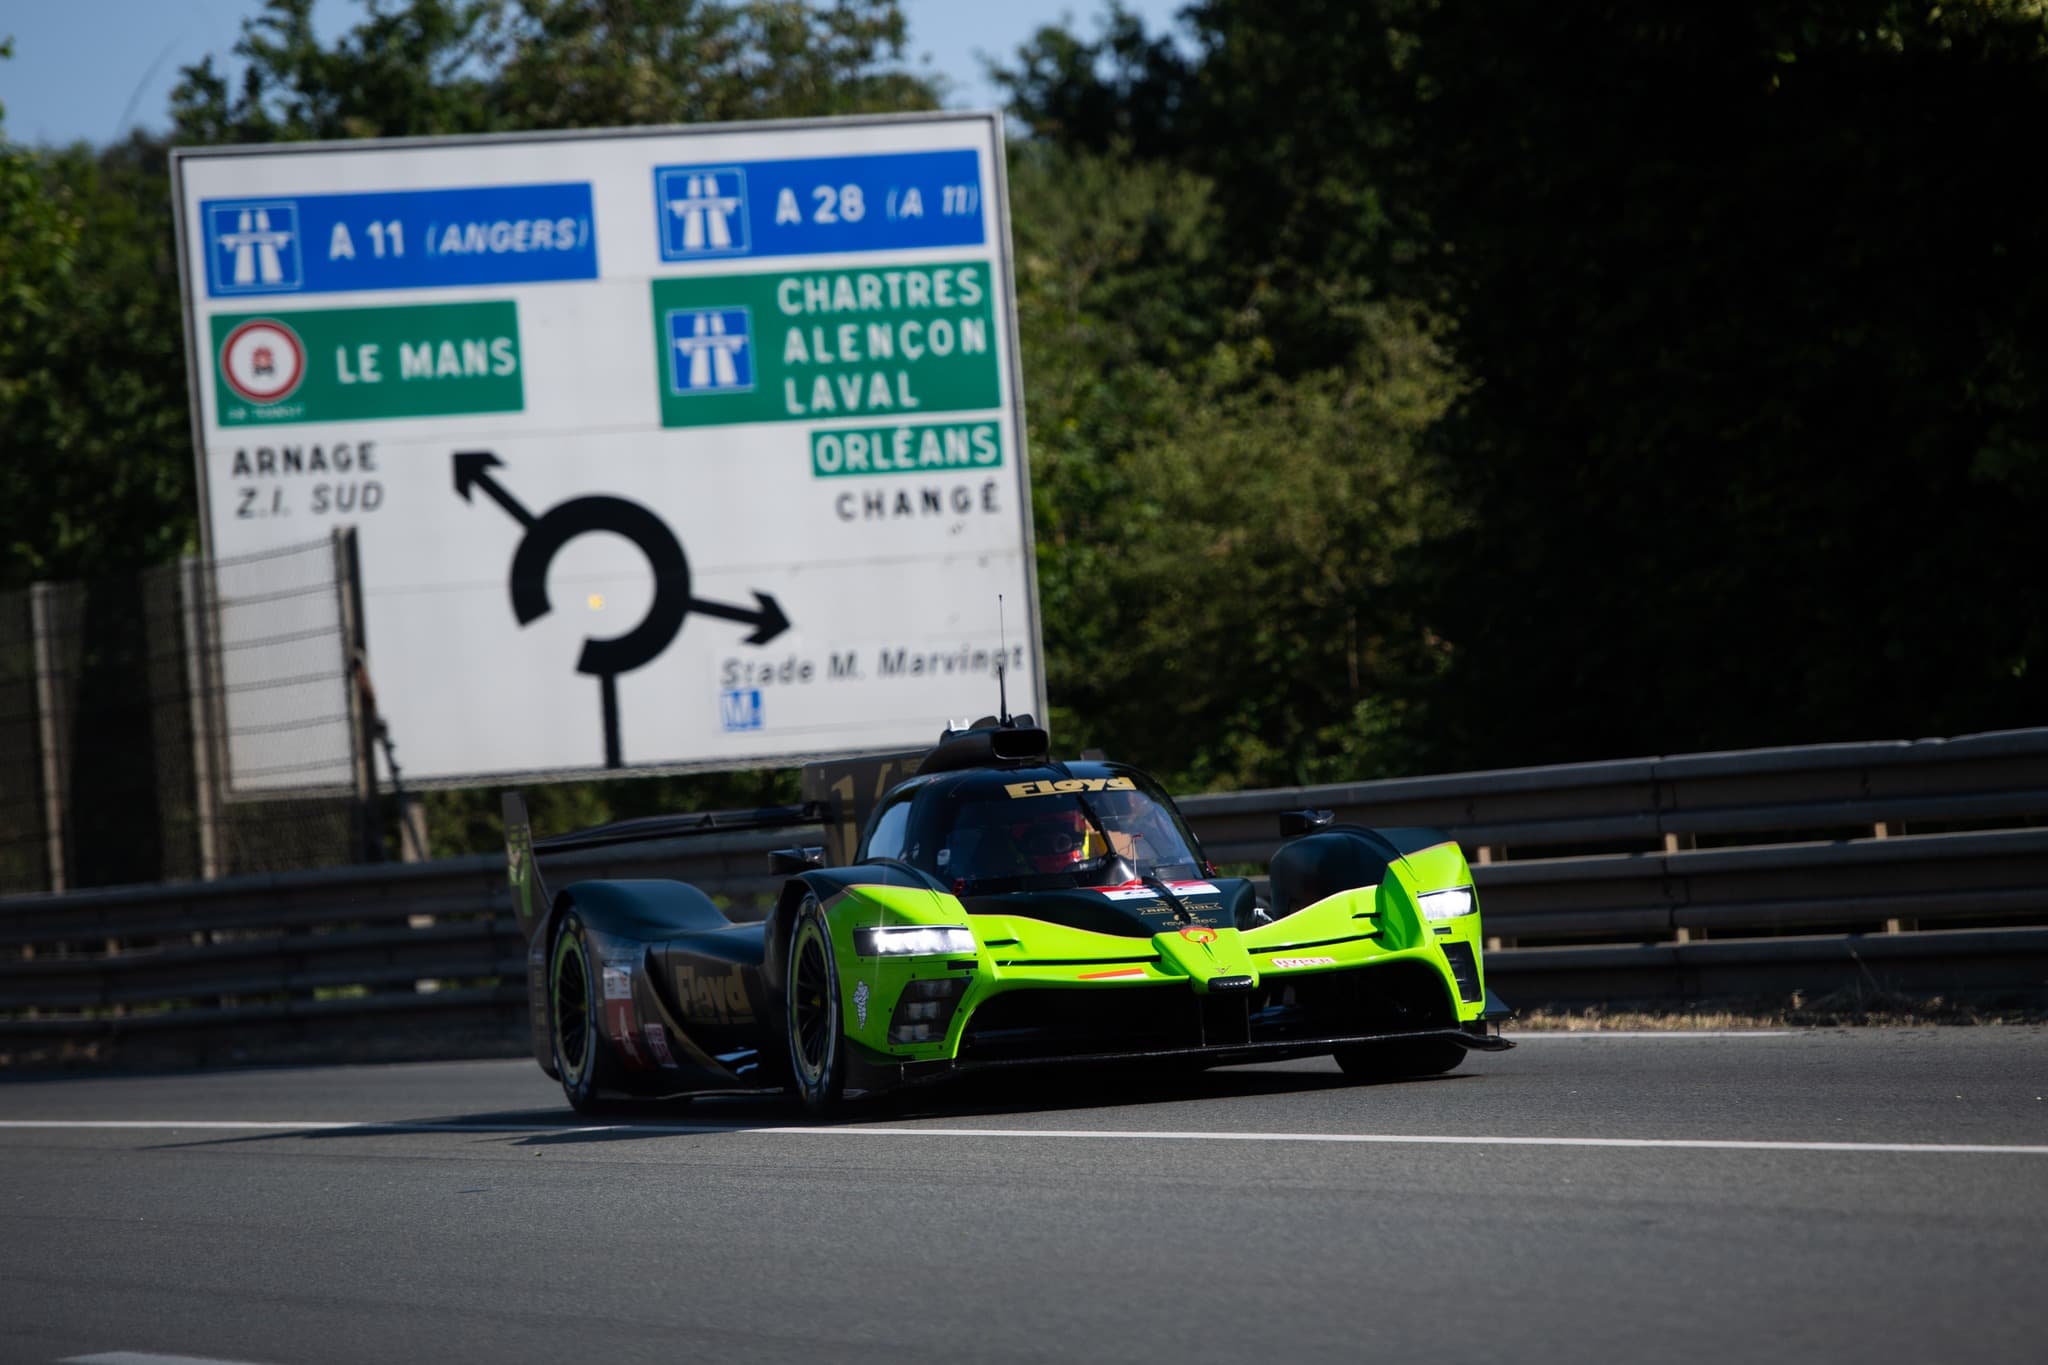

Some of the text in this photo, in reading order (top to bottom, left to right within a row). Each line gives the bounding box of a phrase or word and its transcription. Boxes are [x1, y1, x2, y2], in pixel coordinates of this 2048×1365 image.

[776, 182, 979, 225] A 28 (A 11)
[329, 217, 588, 260] A 11 (ANGERS)
[777, 267, 983, 316] CHARTRES
[336, 337, 517, 384] LE MANS
[784, 370, 919, 414] LAVAL
[231, 440, 379, 478] ARNAGE
[815, 424, 998, 473] ORLÉANS
[310, 480, 384, 515] SUD
[836, 479, 1001, 523] CHANGÉ
[720, 645, 1024, 690] Stade M. Marvingt
[1004, 777, 1136, 798] Floyd
[675, 965, 758, 1024] Floyd
